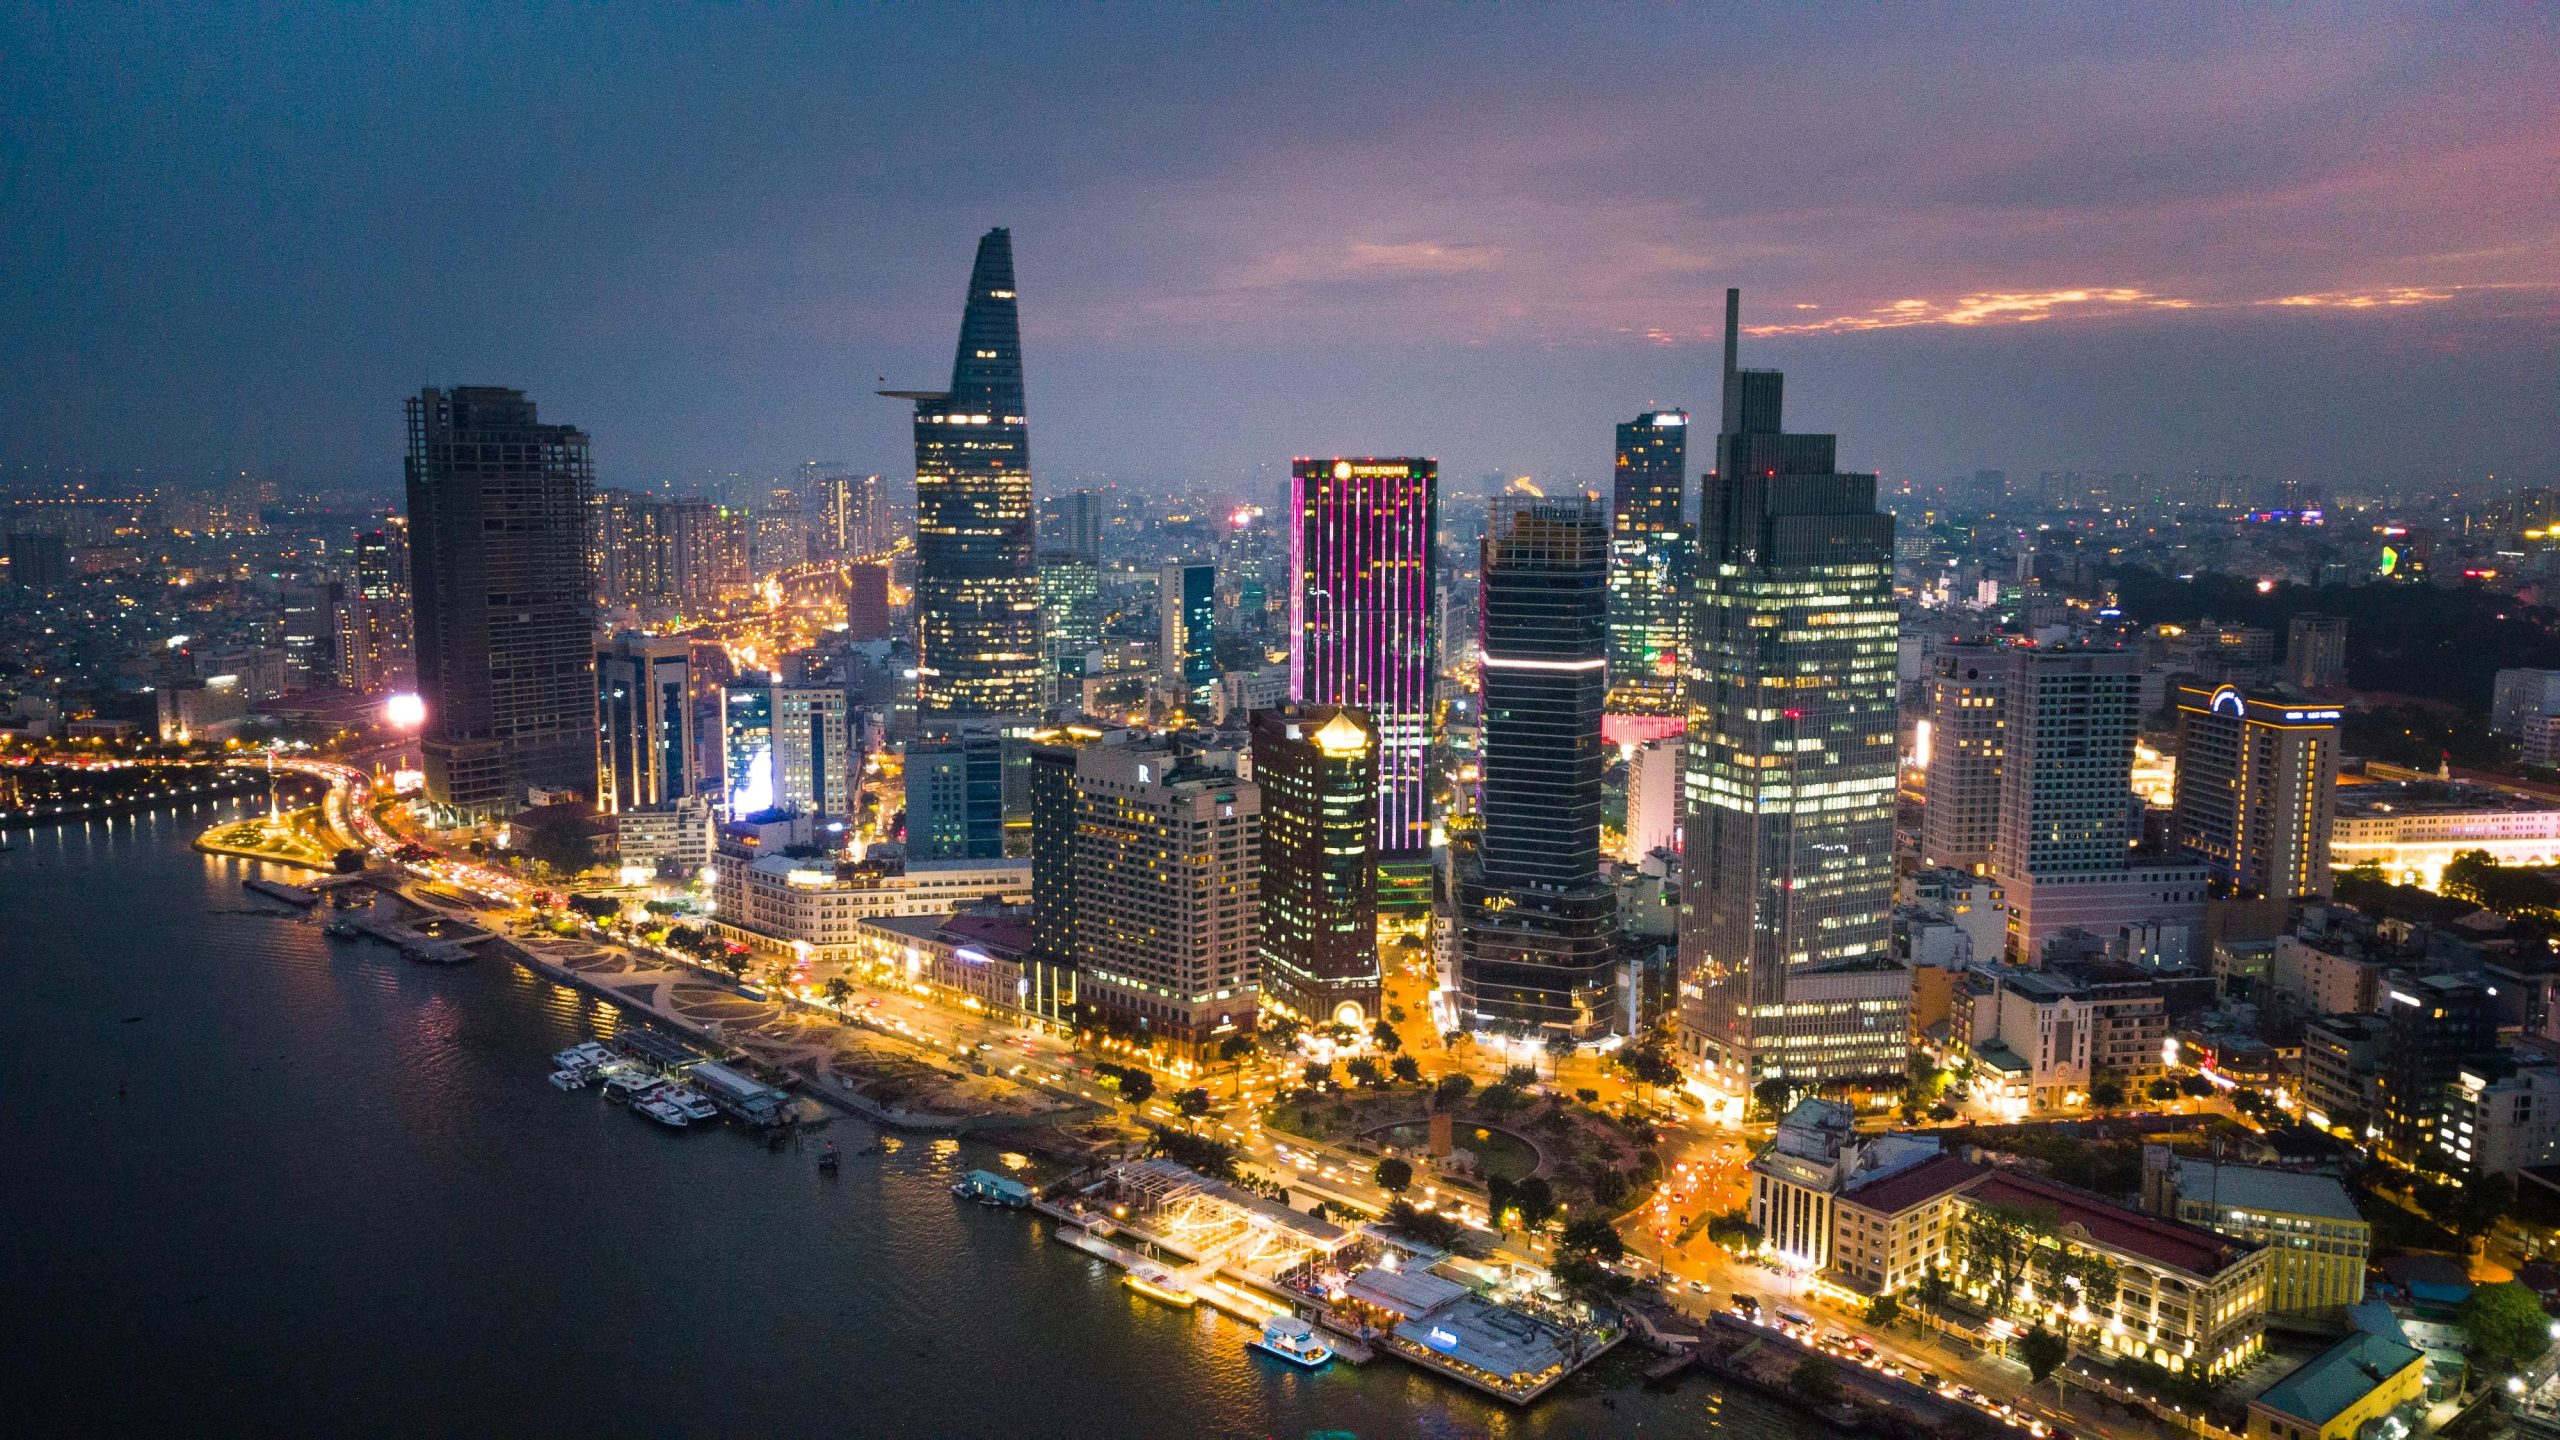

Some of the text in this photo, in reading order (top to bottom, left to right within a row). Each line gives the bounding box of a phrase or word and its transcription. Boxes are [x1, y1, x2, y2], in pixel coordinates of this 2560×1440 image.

[1353, 465, 1409, 475] TIMES SQUARE
[1532, 504, 1577, 519] Hilton
[1138, 764, 1152, 783] R
[1225, 805, 1234, 817] R
